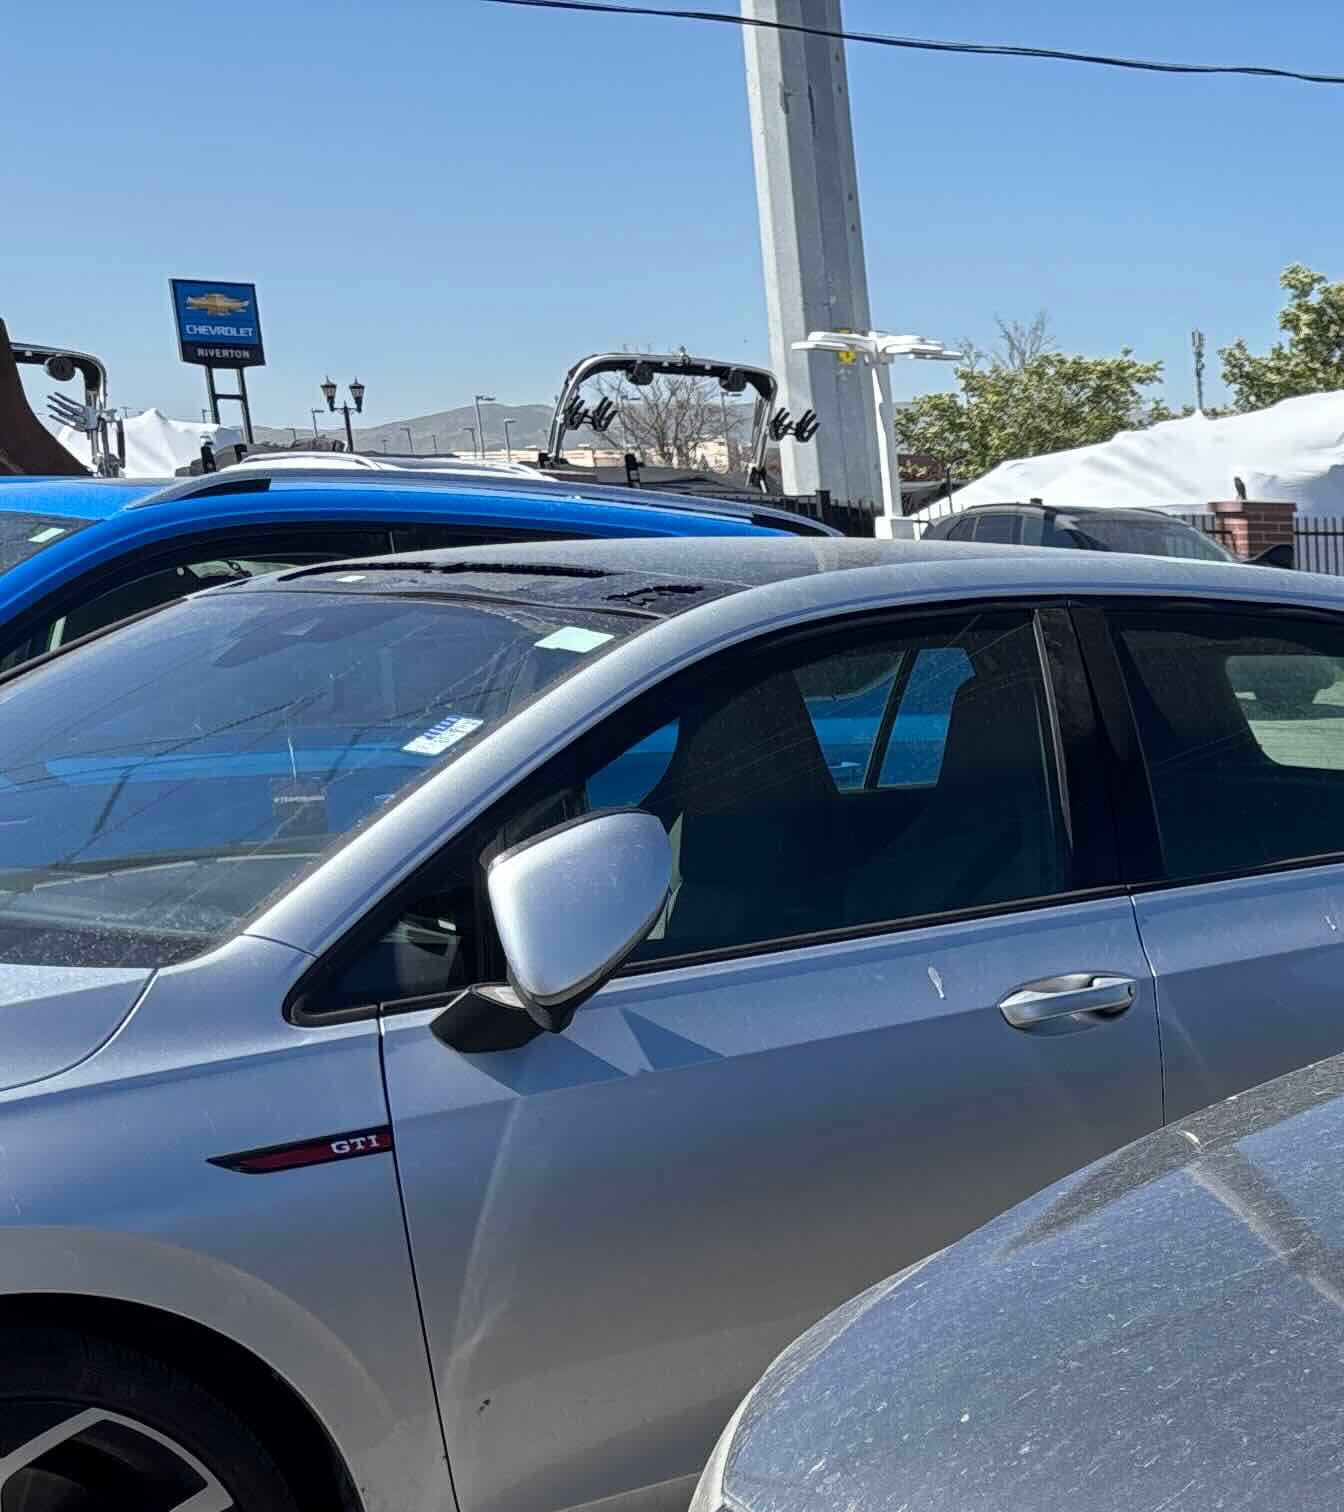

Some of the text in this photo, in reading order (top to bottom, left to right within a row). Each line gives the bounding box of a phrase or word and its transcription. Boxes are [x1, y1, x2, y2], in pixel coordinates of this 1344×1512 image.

[185, 324, 254, 336] CHEVROLET
[196, 348, 250, 359] RIVERTON
[330, 1134, 380, 1154] GTI
